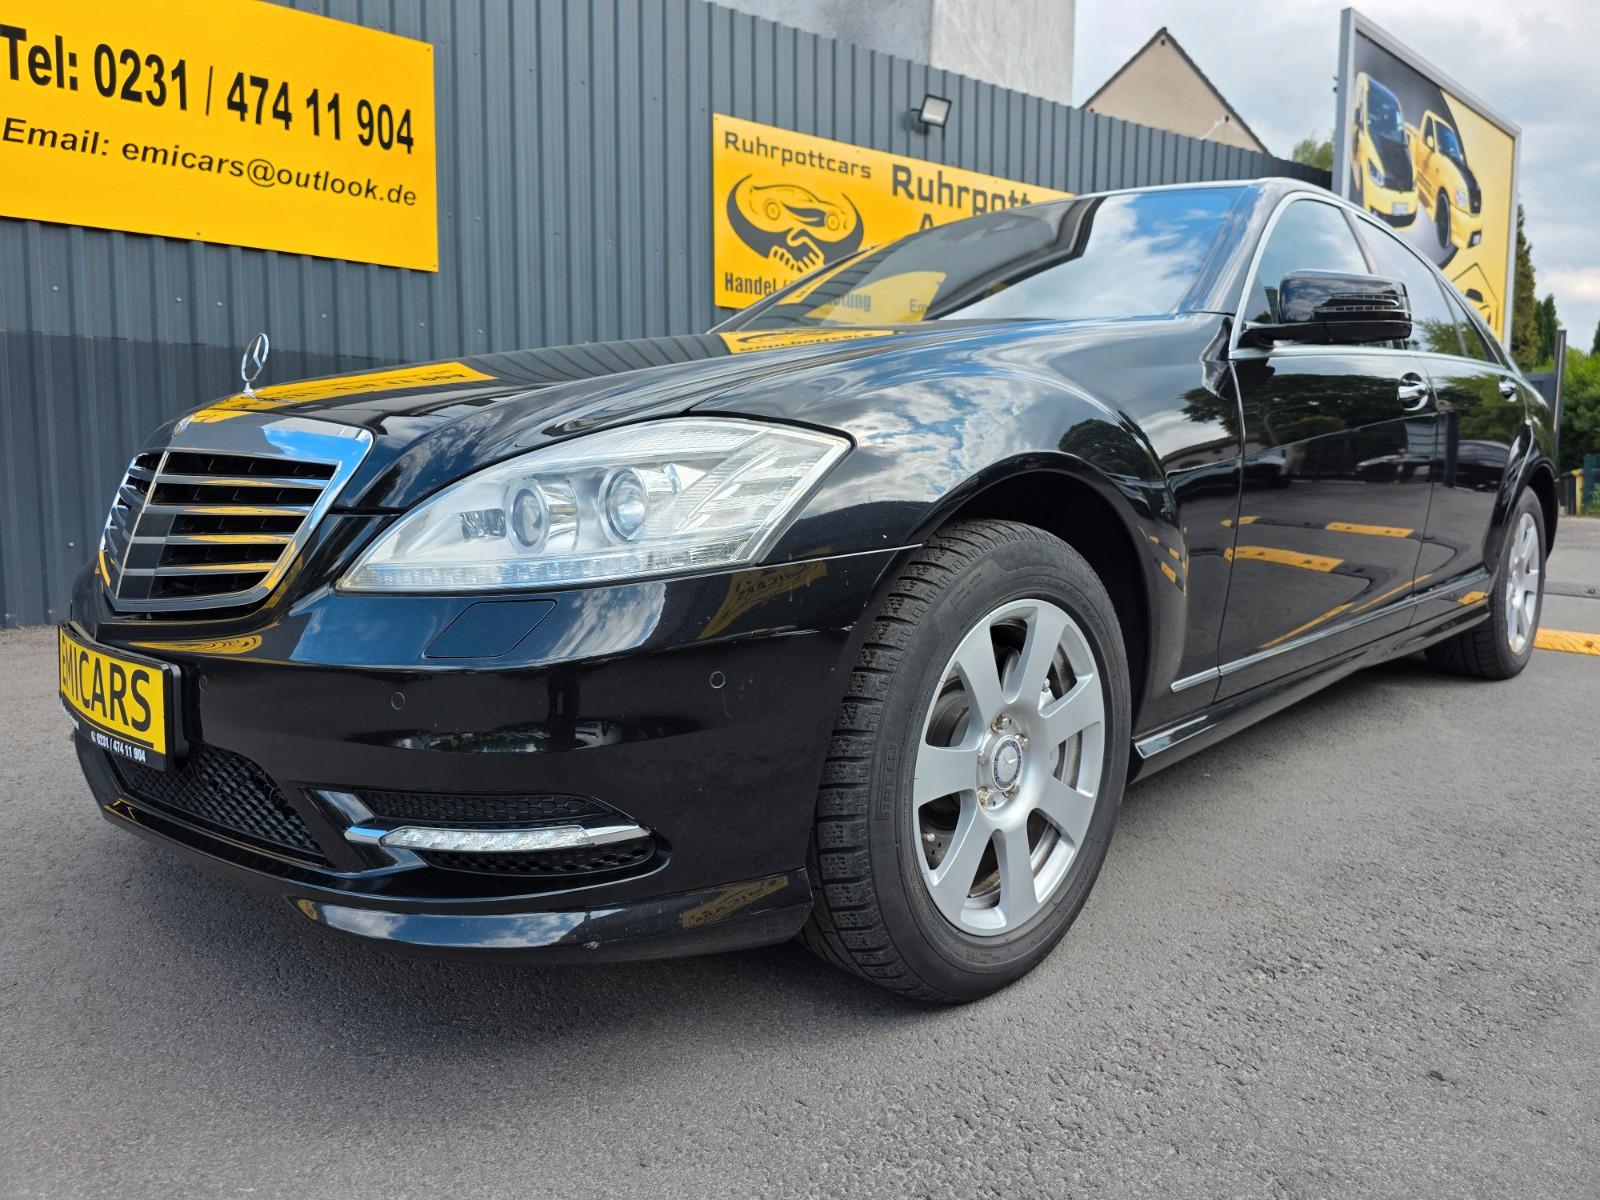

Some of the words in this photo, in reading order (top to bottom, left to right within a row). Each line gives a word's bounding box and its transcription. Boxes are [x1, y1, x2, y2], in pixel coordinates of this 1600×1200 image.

[0, 24, 79, 92] Tel:
[94, 44, 187, 111] 0231
[227, 72, 293, 131] 474
[306, 88, 342, 141] 11
[357, 99, 414, 155] 904
[2, 117, 109, 156] Email:
[121, 143, 418, 206] emicars@outlook.de
[724, 131, 872, 179] Ruhrpottcars
[725, 272, 777, 296] Handel
[62, 634, 152, 733] EMICARS
[113, 740, 125, 755] 474
